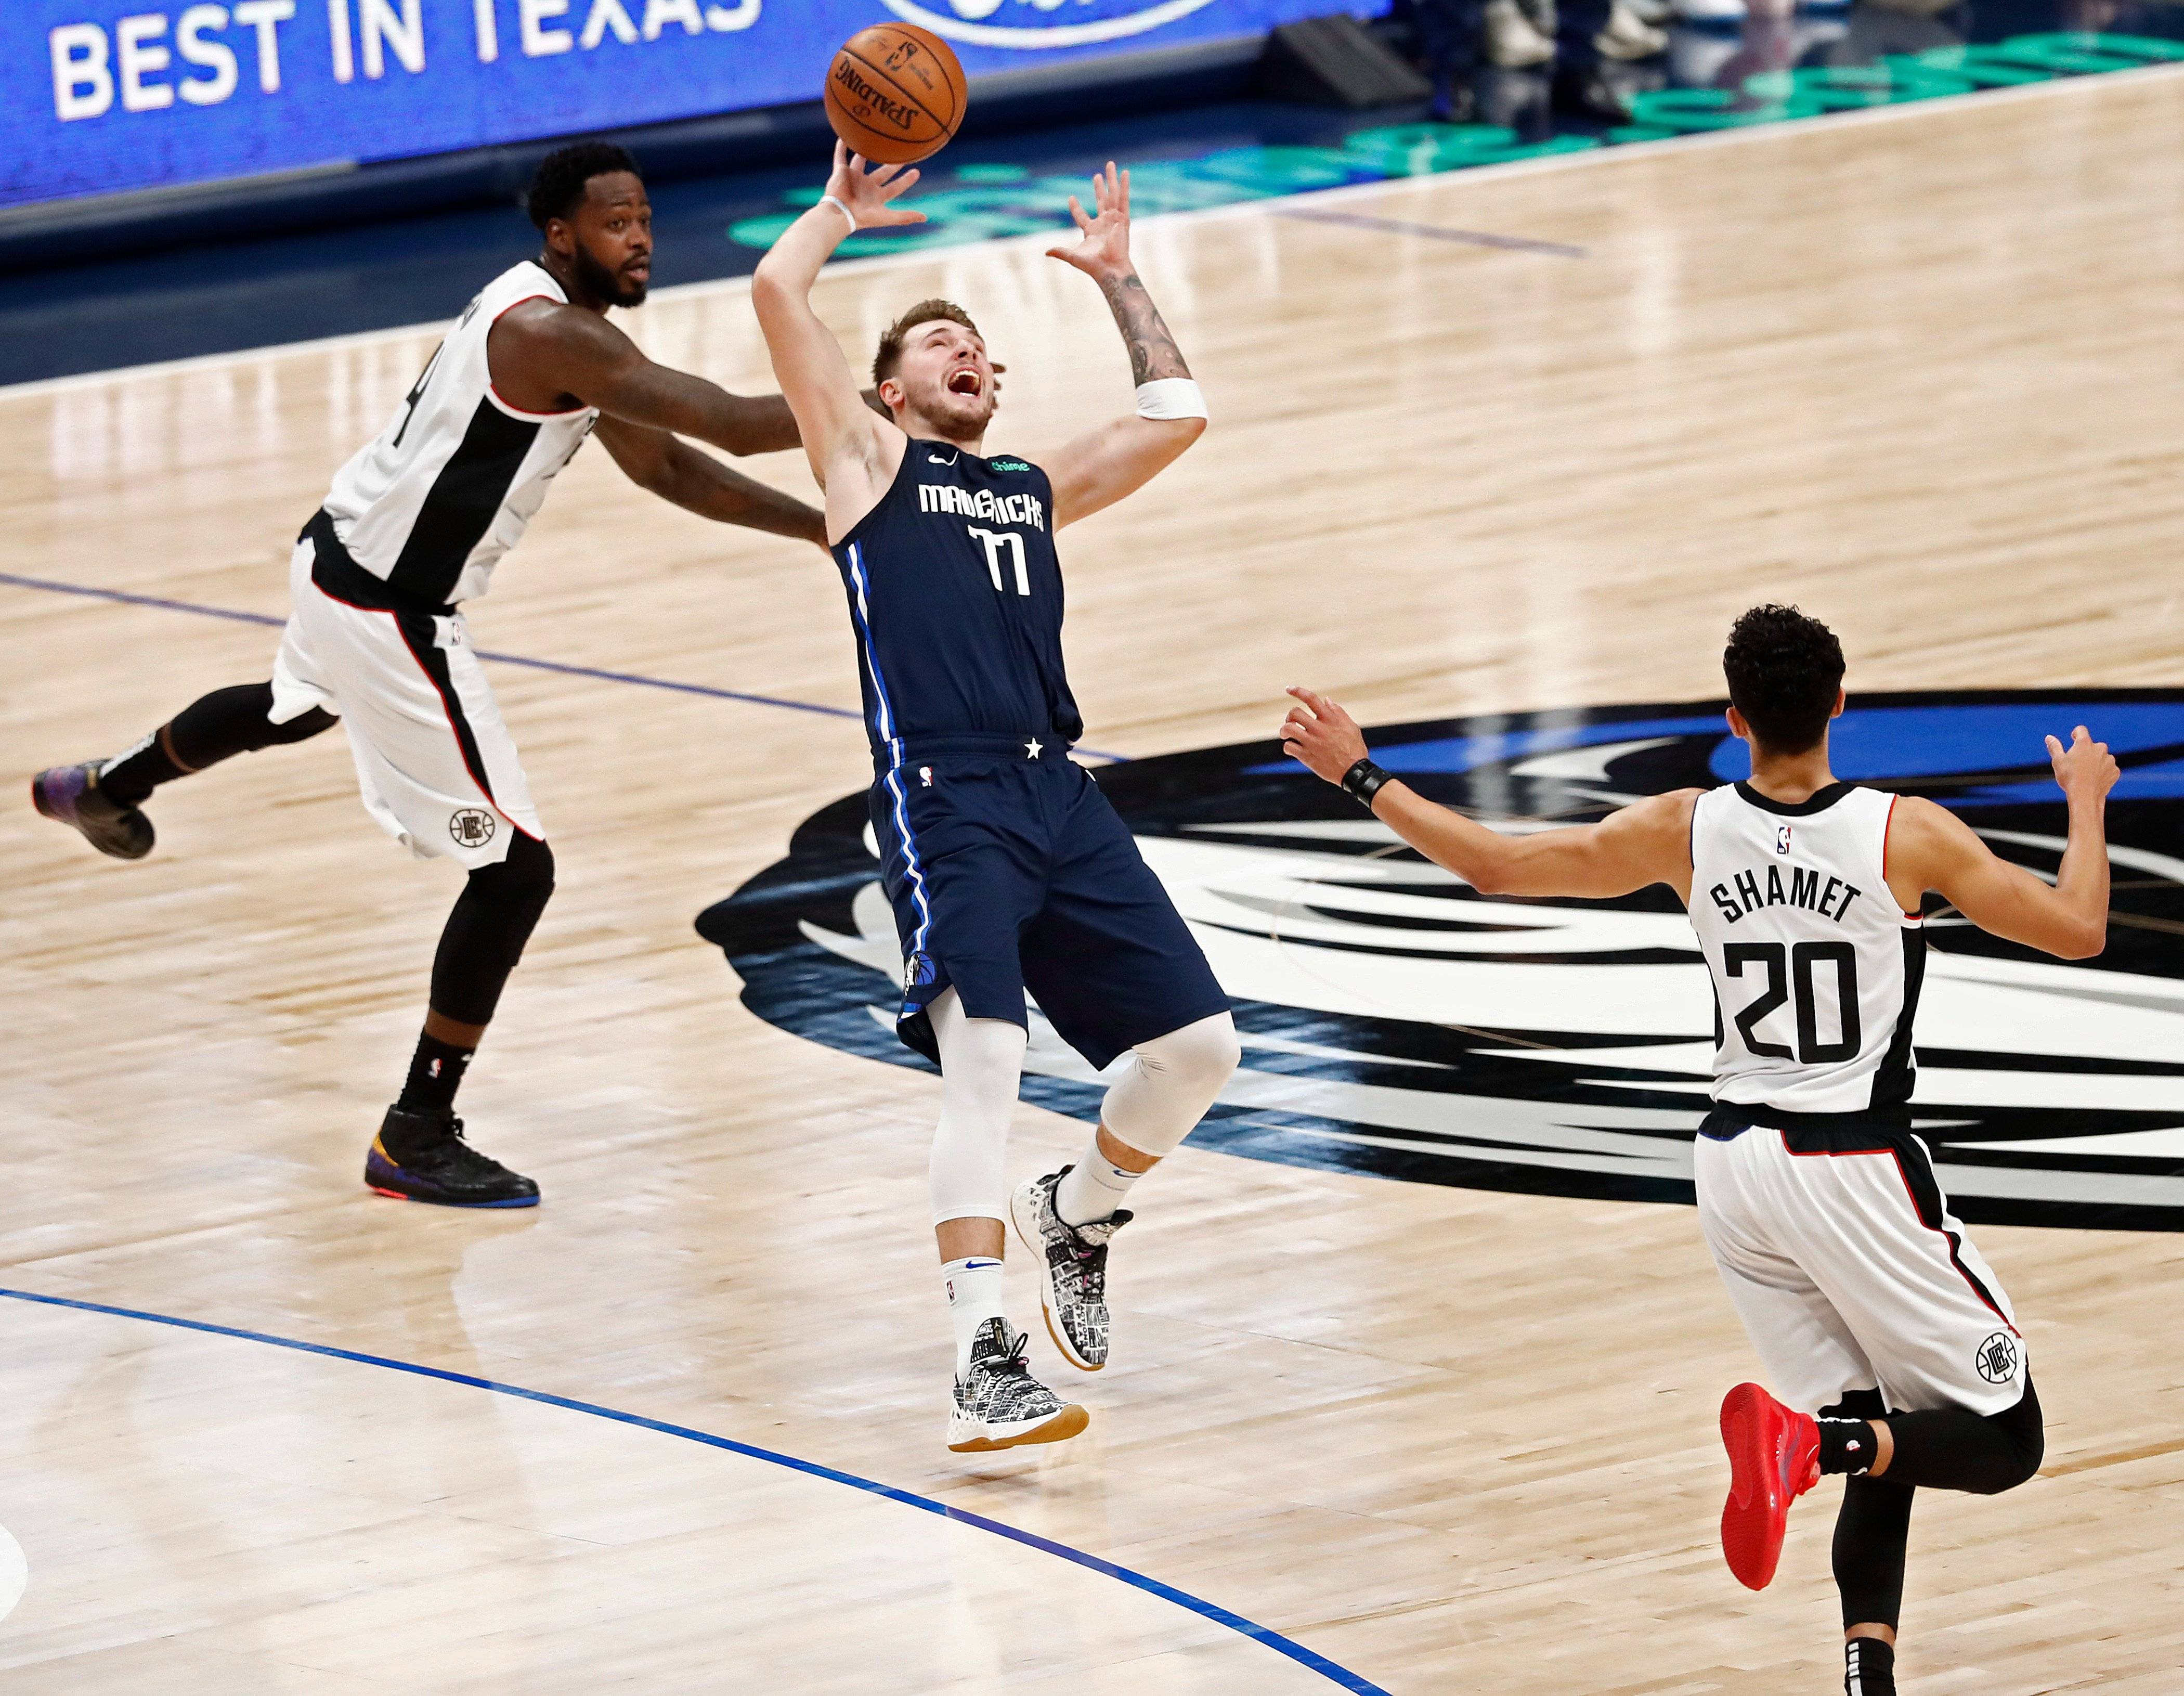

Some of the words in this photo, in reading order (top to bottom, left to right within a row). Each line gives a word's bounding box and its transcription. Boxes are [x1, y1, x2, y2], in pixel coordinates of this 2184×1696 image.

[49, 0, 296, 122] BEST
[328, 0, 426, 84] IN
[835, 56, 919, 130] SPALDING
[918, 484, 1044, 533] MAVERICKS
[967, 524, 1031, 596] 77
[1710, 864, 1862, 924] SHAMET
[1723, 940, 1862, 1064] 20
